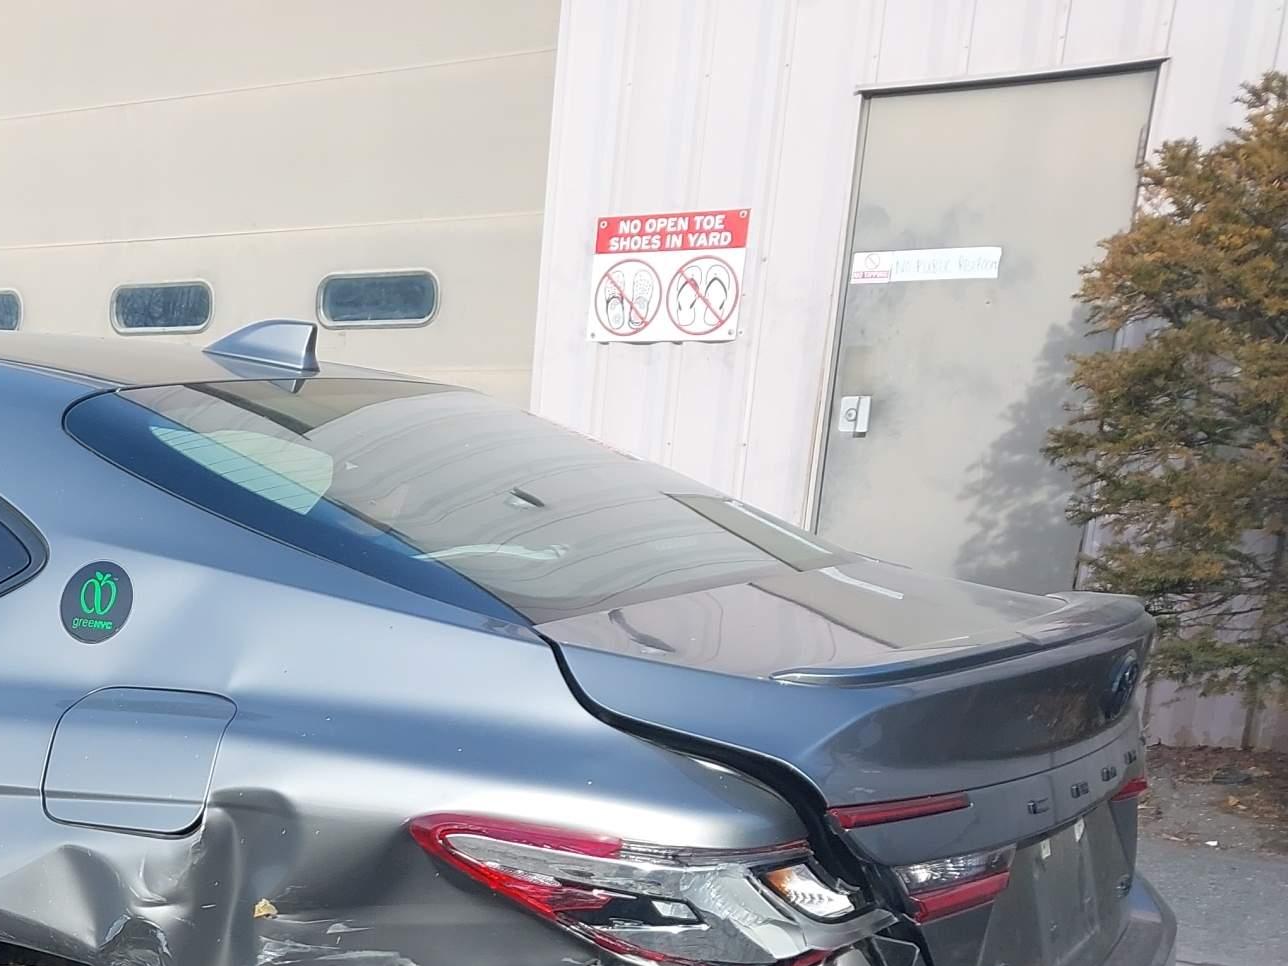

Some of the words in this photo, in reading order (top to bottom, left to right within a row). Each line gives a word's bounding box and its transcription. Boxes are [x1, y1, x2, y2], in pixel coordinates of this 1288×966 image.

[619, 218, 641, 234] NO
[645, 216, 689, 232] OPEN
[694, 214, 725, 230] TOE
[609, 235, 661, 251] SHOES
[665, 234, 680, 249] IN
[688, 231, 732, 248] YARD
